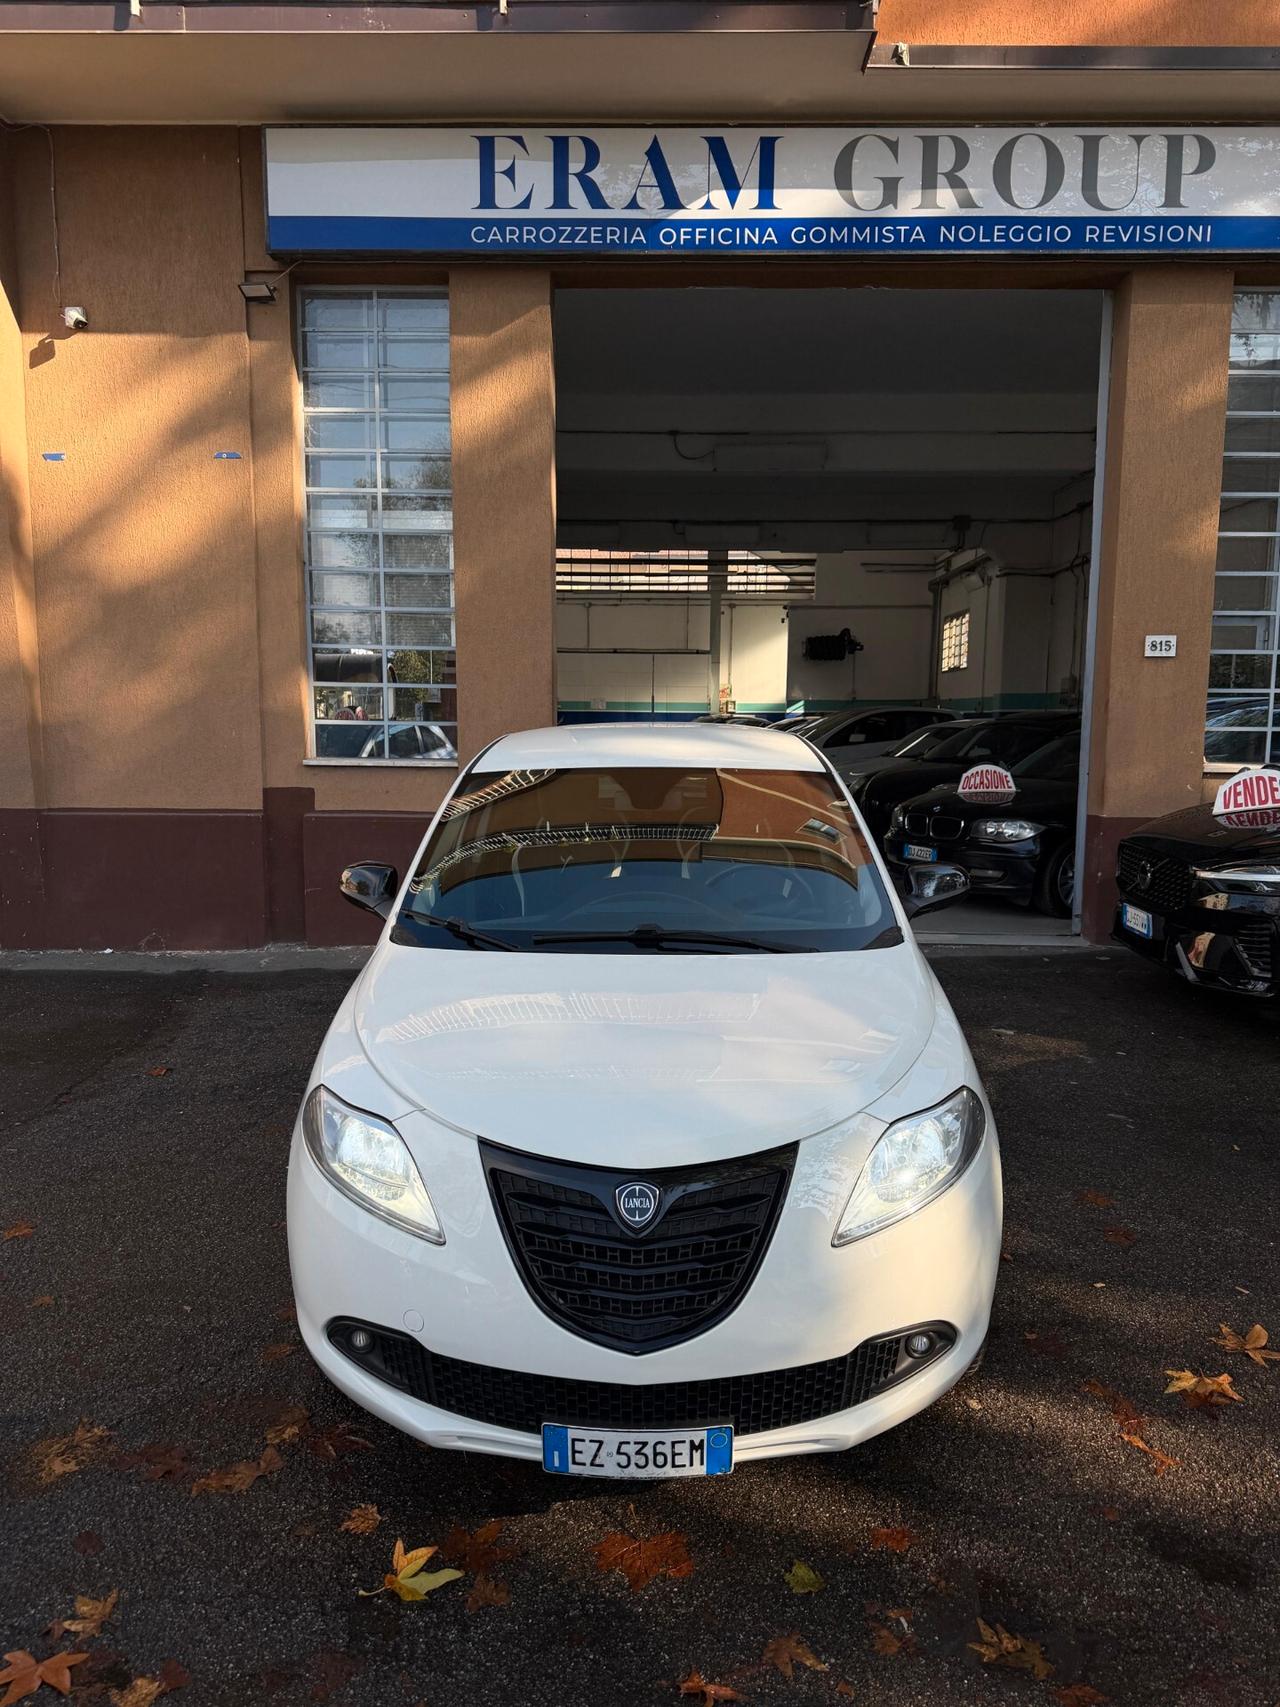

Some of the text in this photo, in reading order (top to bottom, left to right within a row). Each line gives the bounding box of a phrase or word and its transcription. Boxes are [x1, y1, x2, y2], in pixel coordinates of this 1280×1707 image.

[470, 133, 1217, 211] ERAM GROUP
[470, 224, 1212, 245] CARROZZERIA OFFICINA GOMMISTA NOLEGGIO REVISIONI
[1150, 640, 1172, 652] 815
[962, 769, 1012, 790] OCCASIONE
[625, 1197, 650, 1208] LANCIA
[571, 1438, 604, 1467] EZ
[616, 1438, 705, 1469] 536EM
